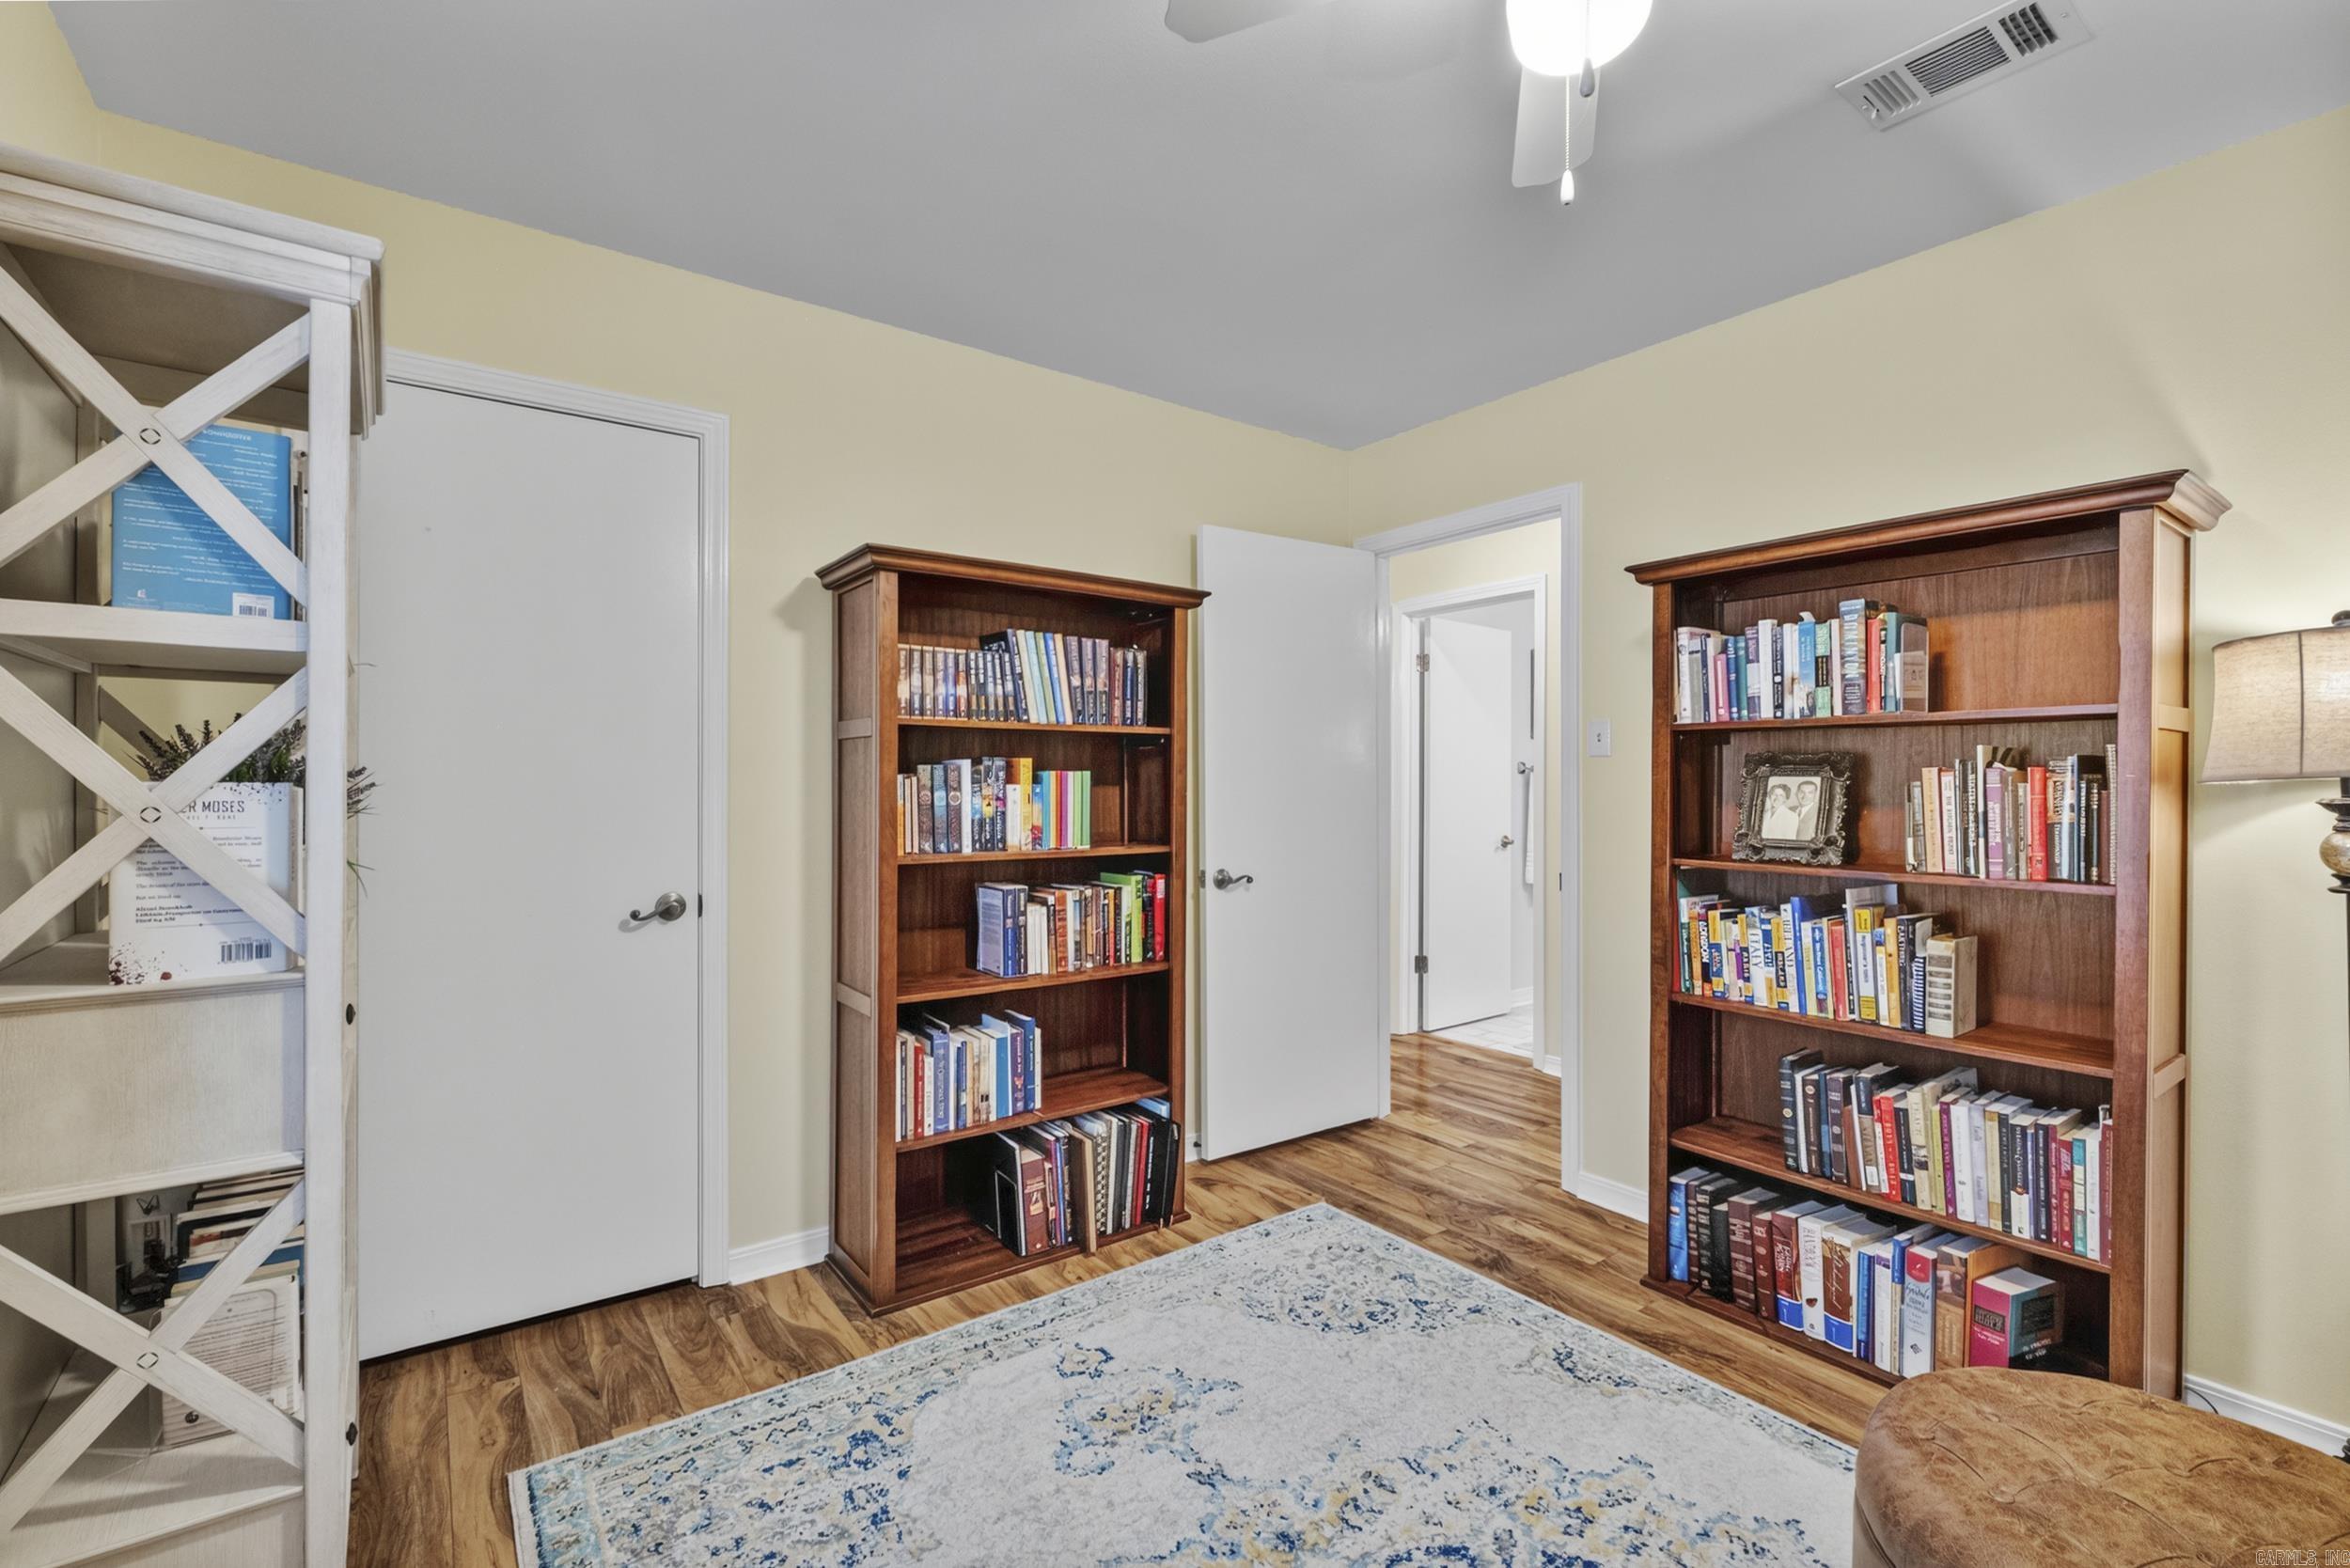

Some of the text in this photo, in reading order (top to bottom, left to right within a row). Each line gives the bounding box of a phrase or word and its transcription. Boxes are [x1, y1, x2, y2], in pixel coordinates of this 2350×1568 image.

[201, 800, 245, 813] MOSES
[1699, 921, 1710, 964] LONDON
[1749, 933, 1763, 969] ITALY
[1783, 919, 1794, 968] IRELAND
